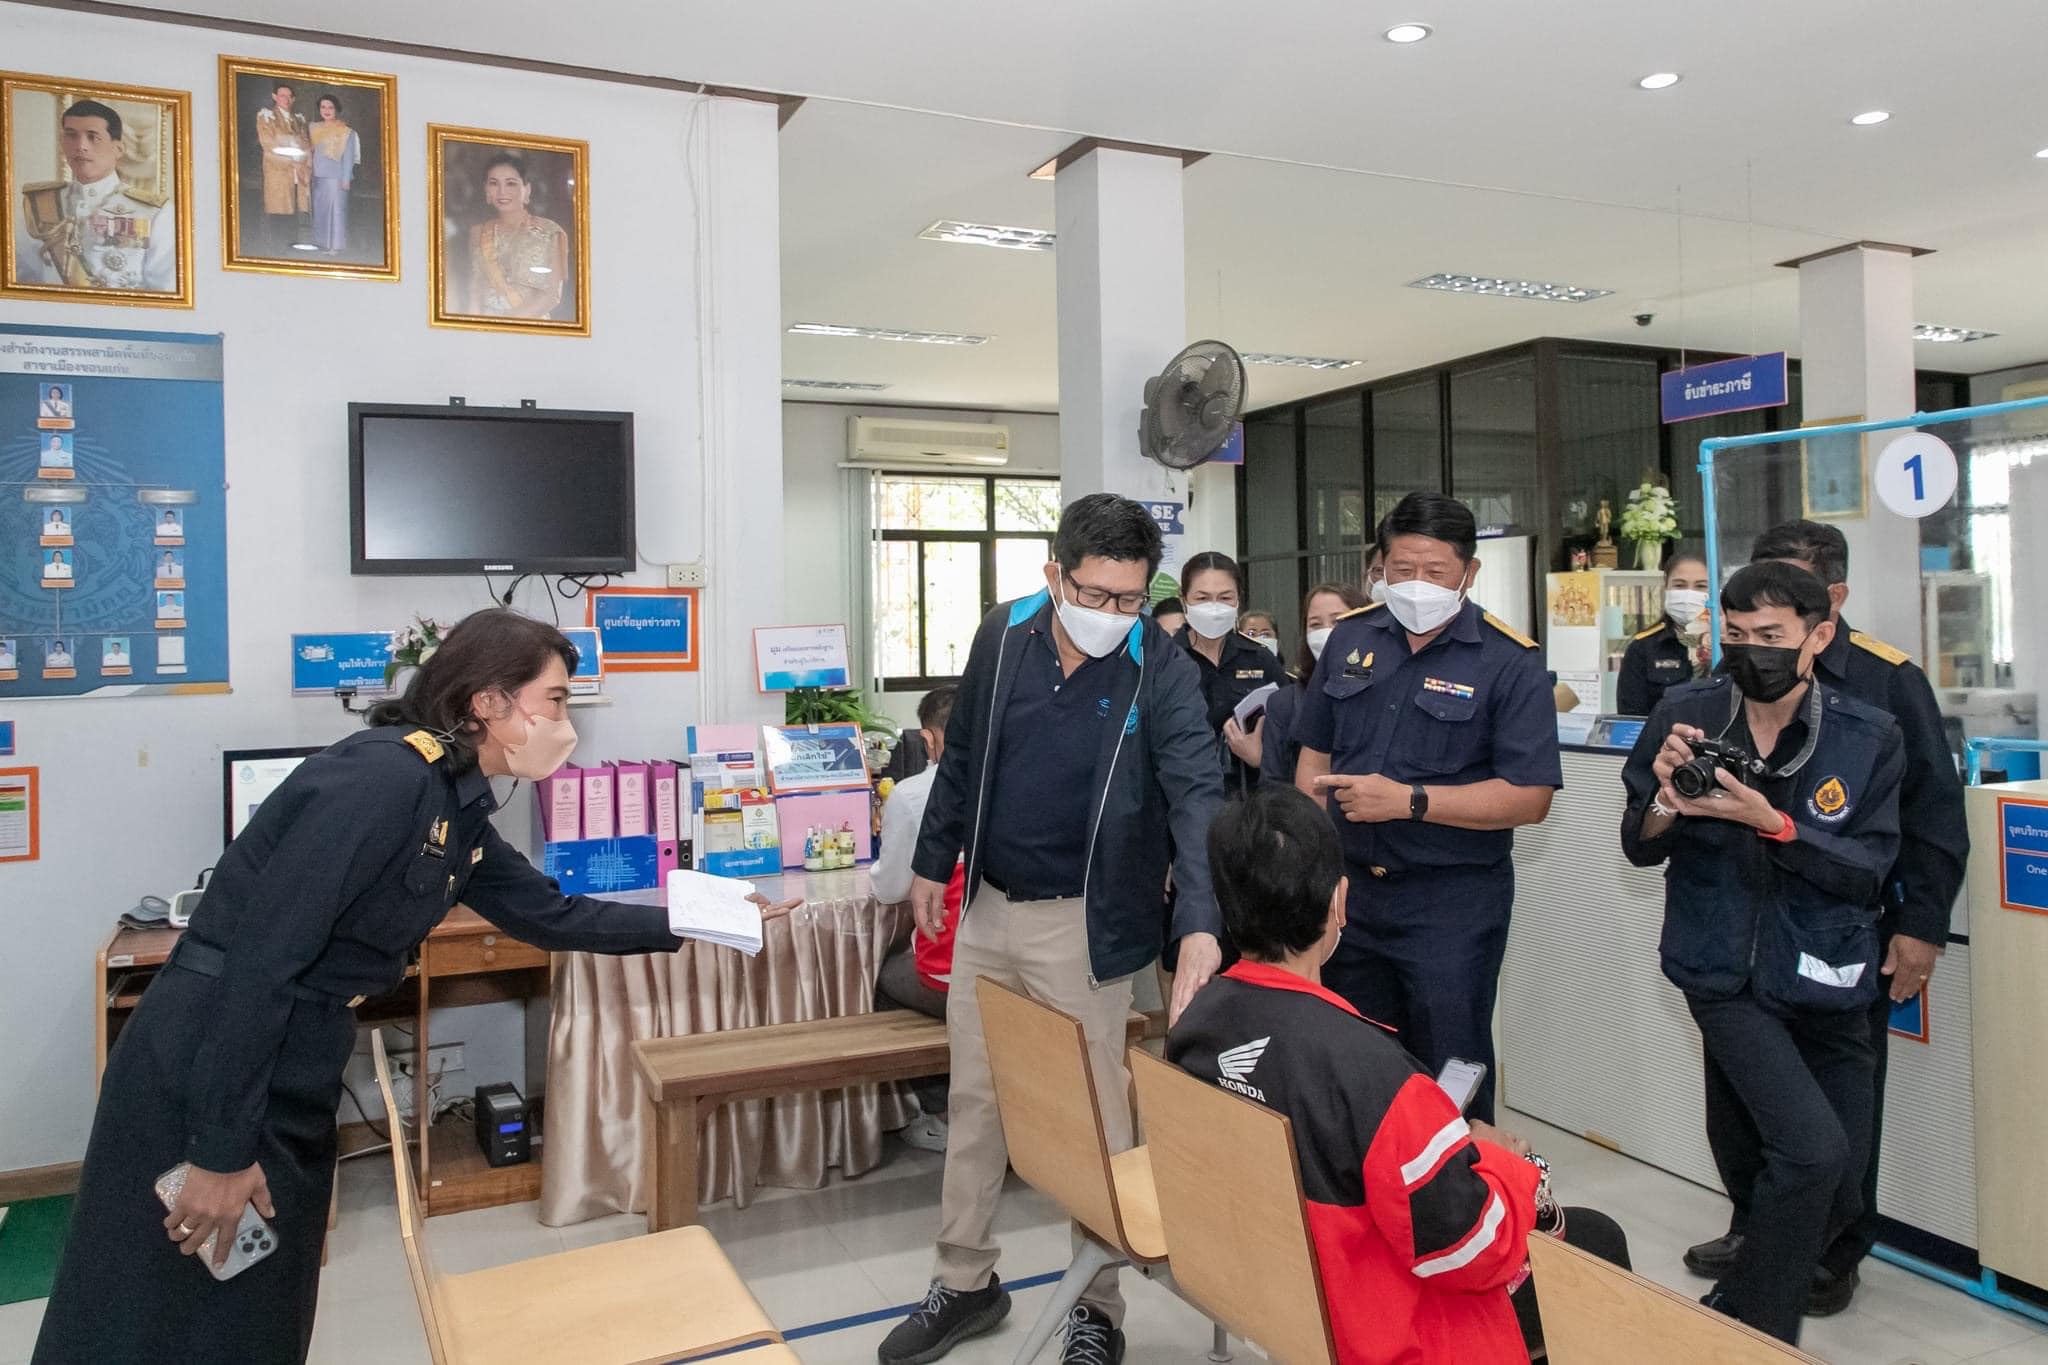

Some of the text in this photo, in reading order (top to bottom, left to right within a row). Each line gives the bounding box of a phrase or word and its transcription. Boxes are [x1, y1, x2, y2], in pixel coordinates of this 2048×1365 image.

[1684, 371, 1752, 400] รับชำระภาษี
[1904, 454, 1924, 501] 1
[603, 616, 681, 631] ศูนย์ข้อมูลข่าวสาร
[339, 676, 385, 686] คอมพิวเตอ
[2026, 864, 2048, 876] One
[1216, 1077, 1267, 1103] HONDA
